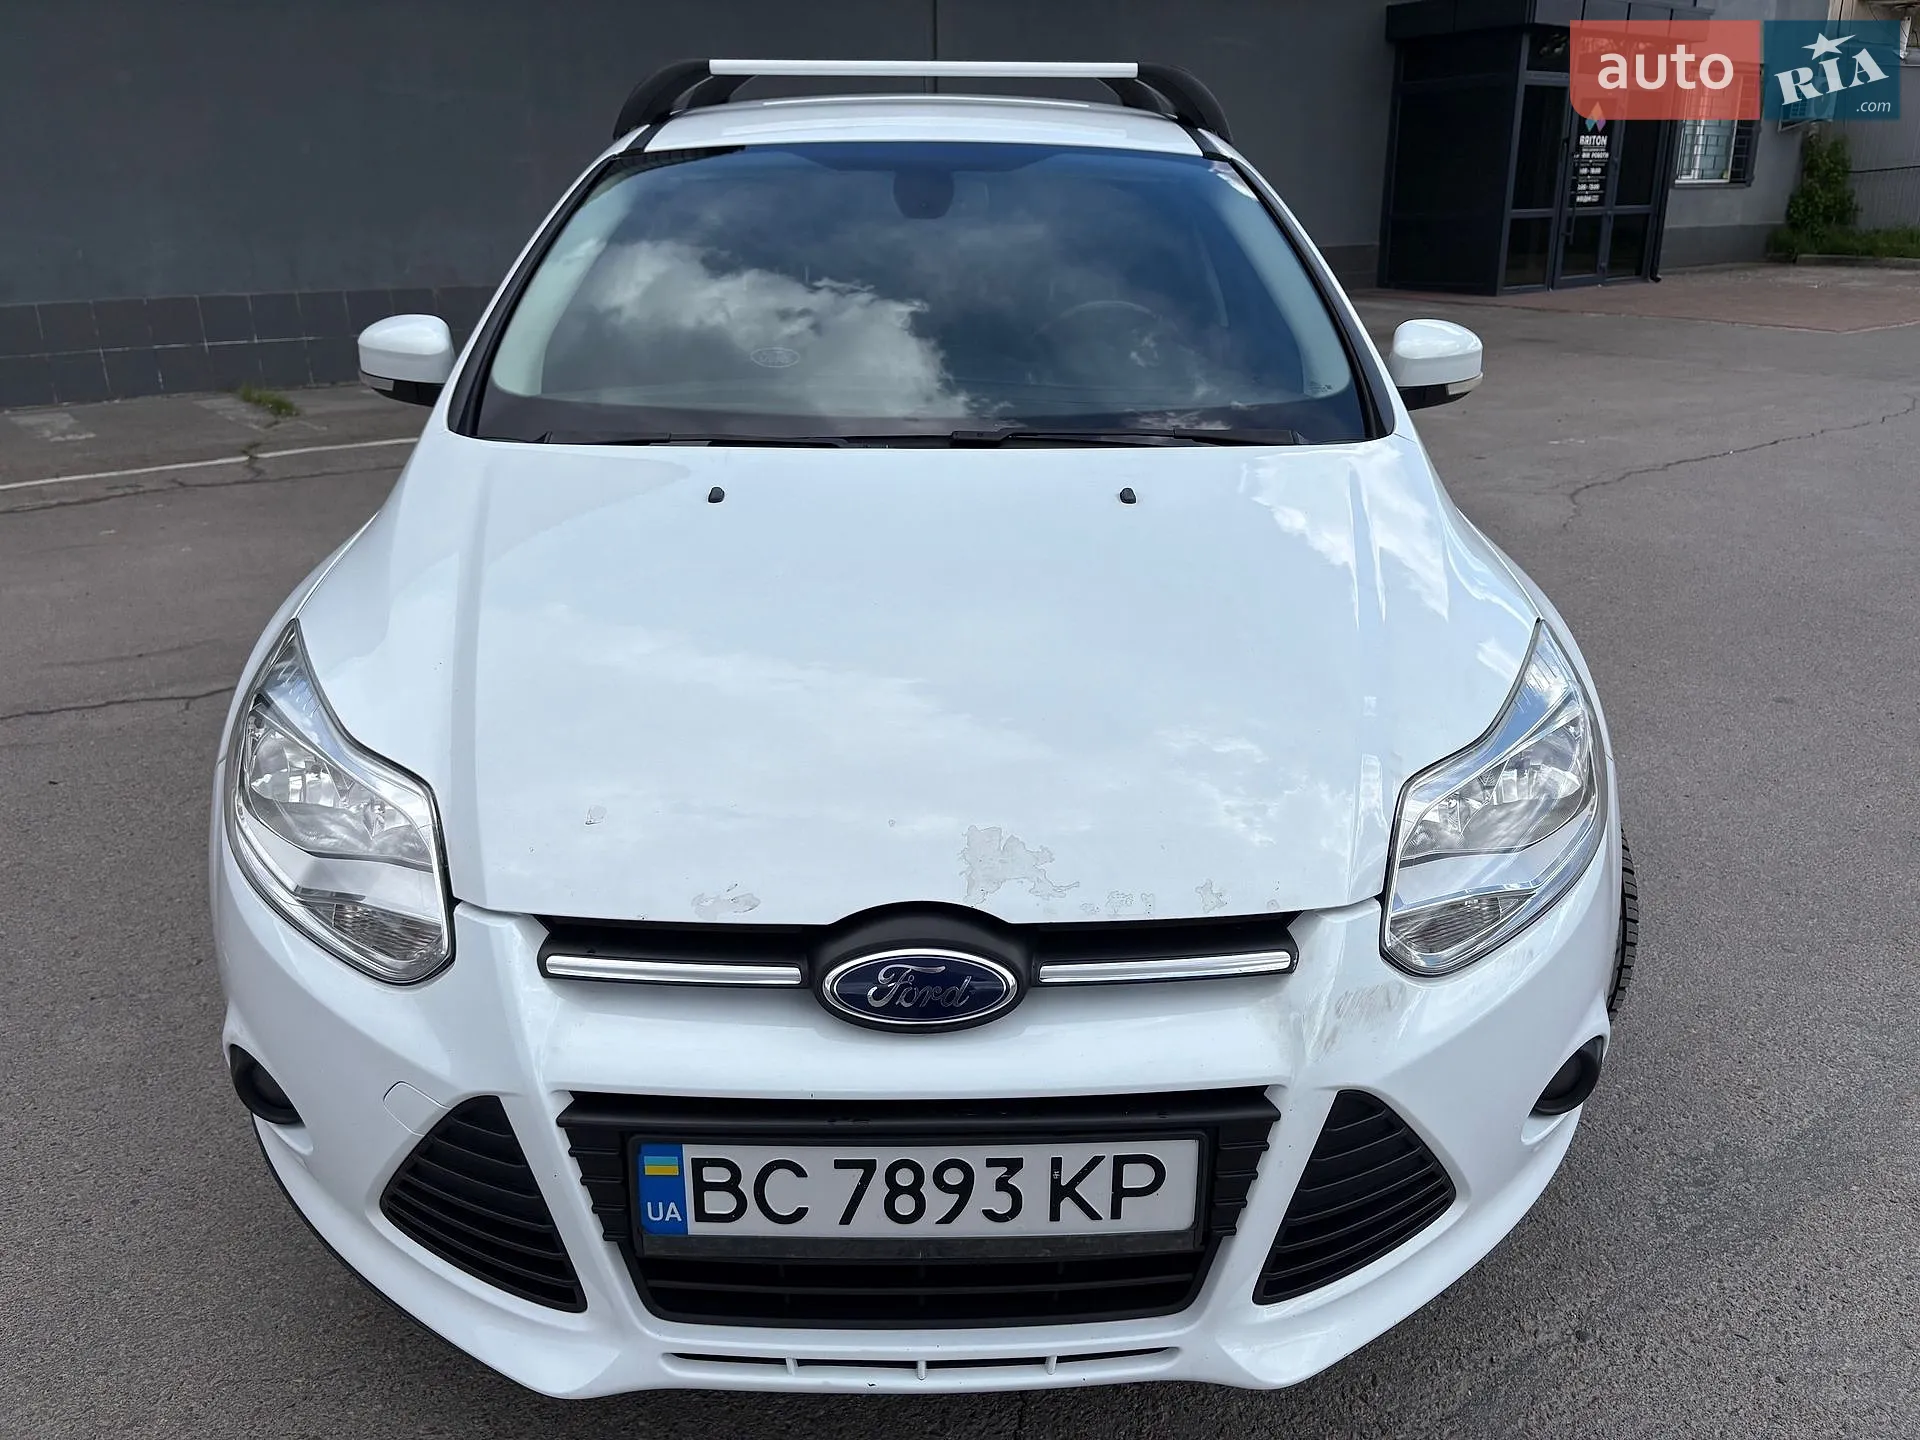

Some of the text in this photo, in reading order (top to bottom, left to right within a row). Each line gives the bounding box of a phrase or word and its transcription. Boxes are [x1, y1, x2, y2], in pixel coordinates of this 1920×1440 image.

[1579, 135, 1608, 145] BRITON
[867, 963, 972, 1008] Ford
[690, 1152, 1168, 1226] BC 7893 KP
[646, 1201, 683, 1223] UA
